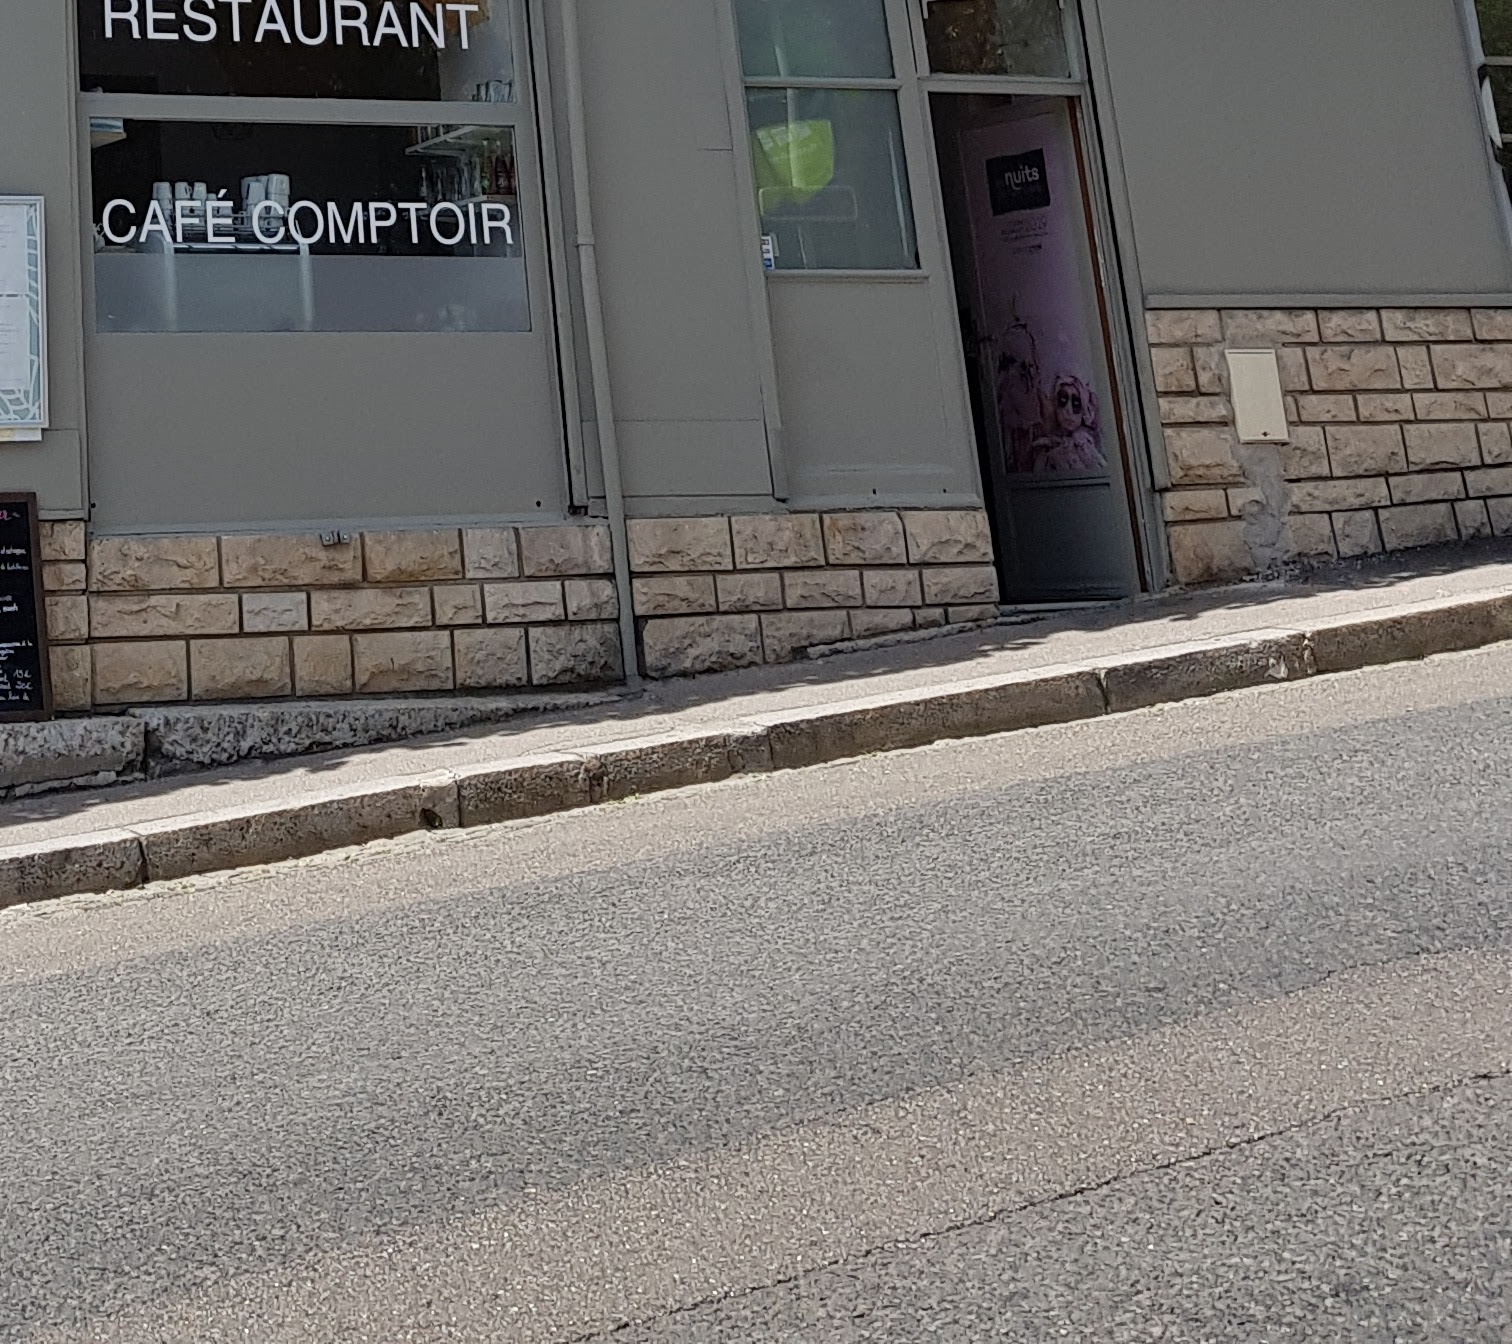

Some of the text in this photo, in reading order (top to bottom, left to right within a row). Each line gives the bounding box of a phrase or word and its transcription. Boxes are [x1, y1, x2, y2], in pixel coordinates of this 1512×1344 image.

[1004, 165, 1040, 190] nuits
[101, 188, 514, 246] CAFÉ COMPTOIR
